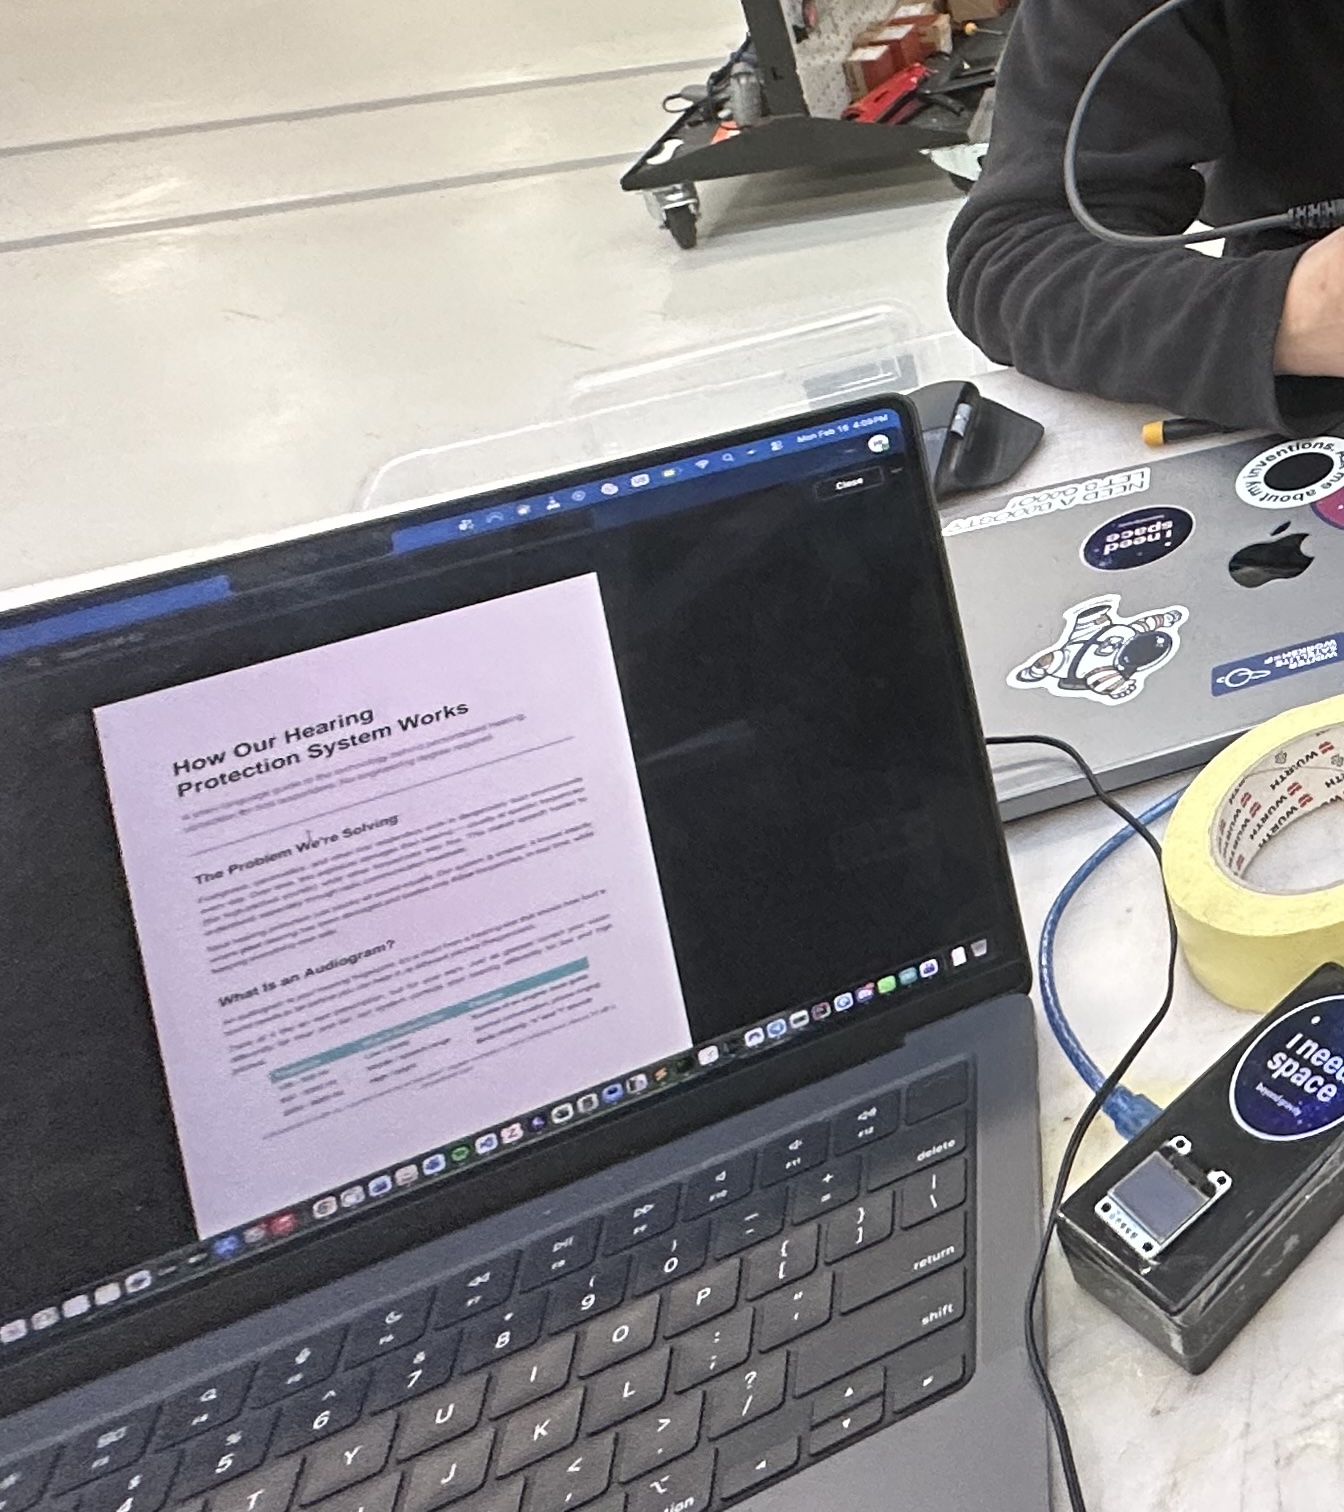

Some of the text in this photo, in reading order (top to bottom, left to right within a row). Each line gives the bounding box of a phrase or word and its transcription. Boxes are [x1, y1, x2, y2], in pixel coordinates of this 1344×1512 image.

[1251, 440, 1334, 479] inventions.
[1246, 476, 1266, 498] my
[1259, 486, 1318, 503] about
[1103, 531, 1160, 556] need
[1105, 520, 1174, 544] space
[172, 706, 375, 776] How Our Hearing
[176, 748, 301, 798] Protection
[307, 724, 392, 763] System
[398, 700, 470, 734] Works
[195, 868, 224, 885] The
[227, 848, 292, 878] Problem
[342, 813, 399, 844] Solving
[218, 986, 258, 1007] What
[279, 973, 301, 988] an
[304, 939, 396, 980] Audiogram?
[1266, 1050, 1338, 1103] space
[916, 1138, 957, 1163] delete
[913, 1244, 956, 1271] return
[580, 1293, 596, 1311] 9
[696, 1287, 712, 1306] P
[921, 1302, 955, 1327] shift
[494, 1330, 511, 1349] 8
[407, 1368, 423, 1389] 7
[622, 1381, 636, 1399] L
[312, 1410, 331, 1430] 6
[435, 1402, 455, 1425] U
[533, 1418, 551, 1442] K
[214, 1452, 235, 1474] 5
[343, 1445, 363, 1466] Y
[440, 1462, 457, 1485] J
[246, 1488, 265, 1511] T
